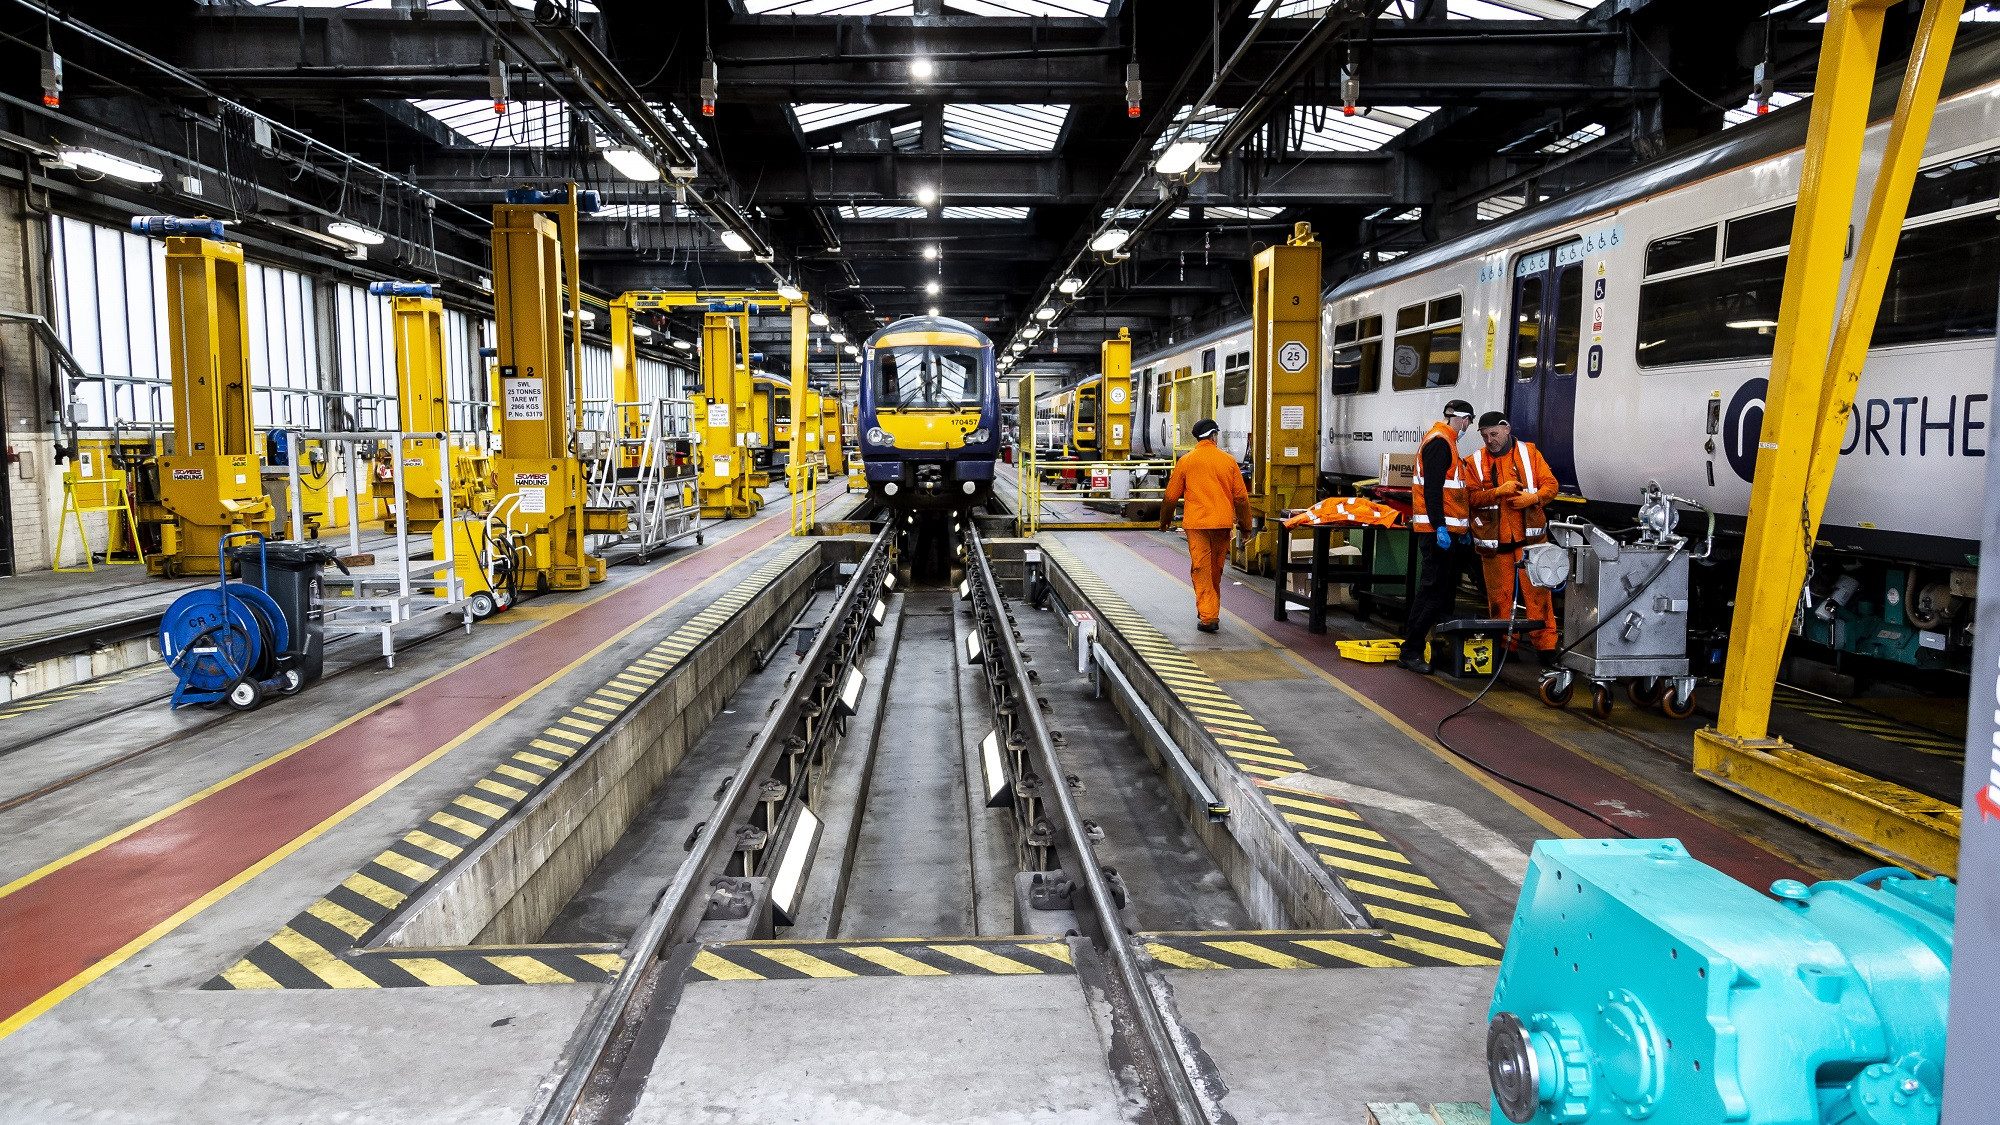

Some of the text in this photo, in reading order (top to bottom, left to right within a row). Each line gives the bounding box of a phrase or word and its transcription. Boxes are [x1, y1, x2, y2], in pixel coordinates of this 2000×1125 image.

[1292, 296, 1300, 306] 3
[1287, 351, 1300, 361] 25
[526, 366, 535, 377] 2
[198, 376, 206, 386] 4
[189, 612, 217, 629] CR 3
